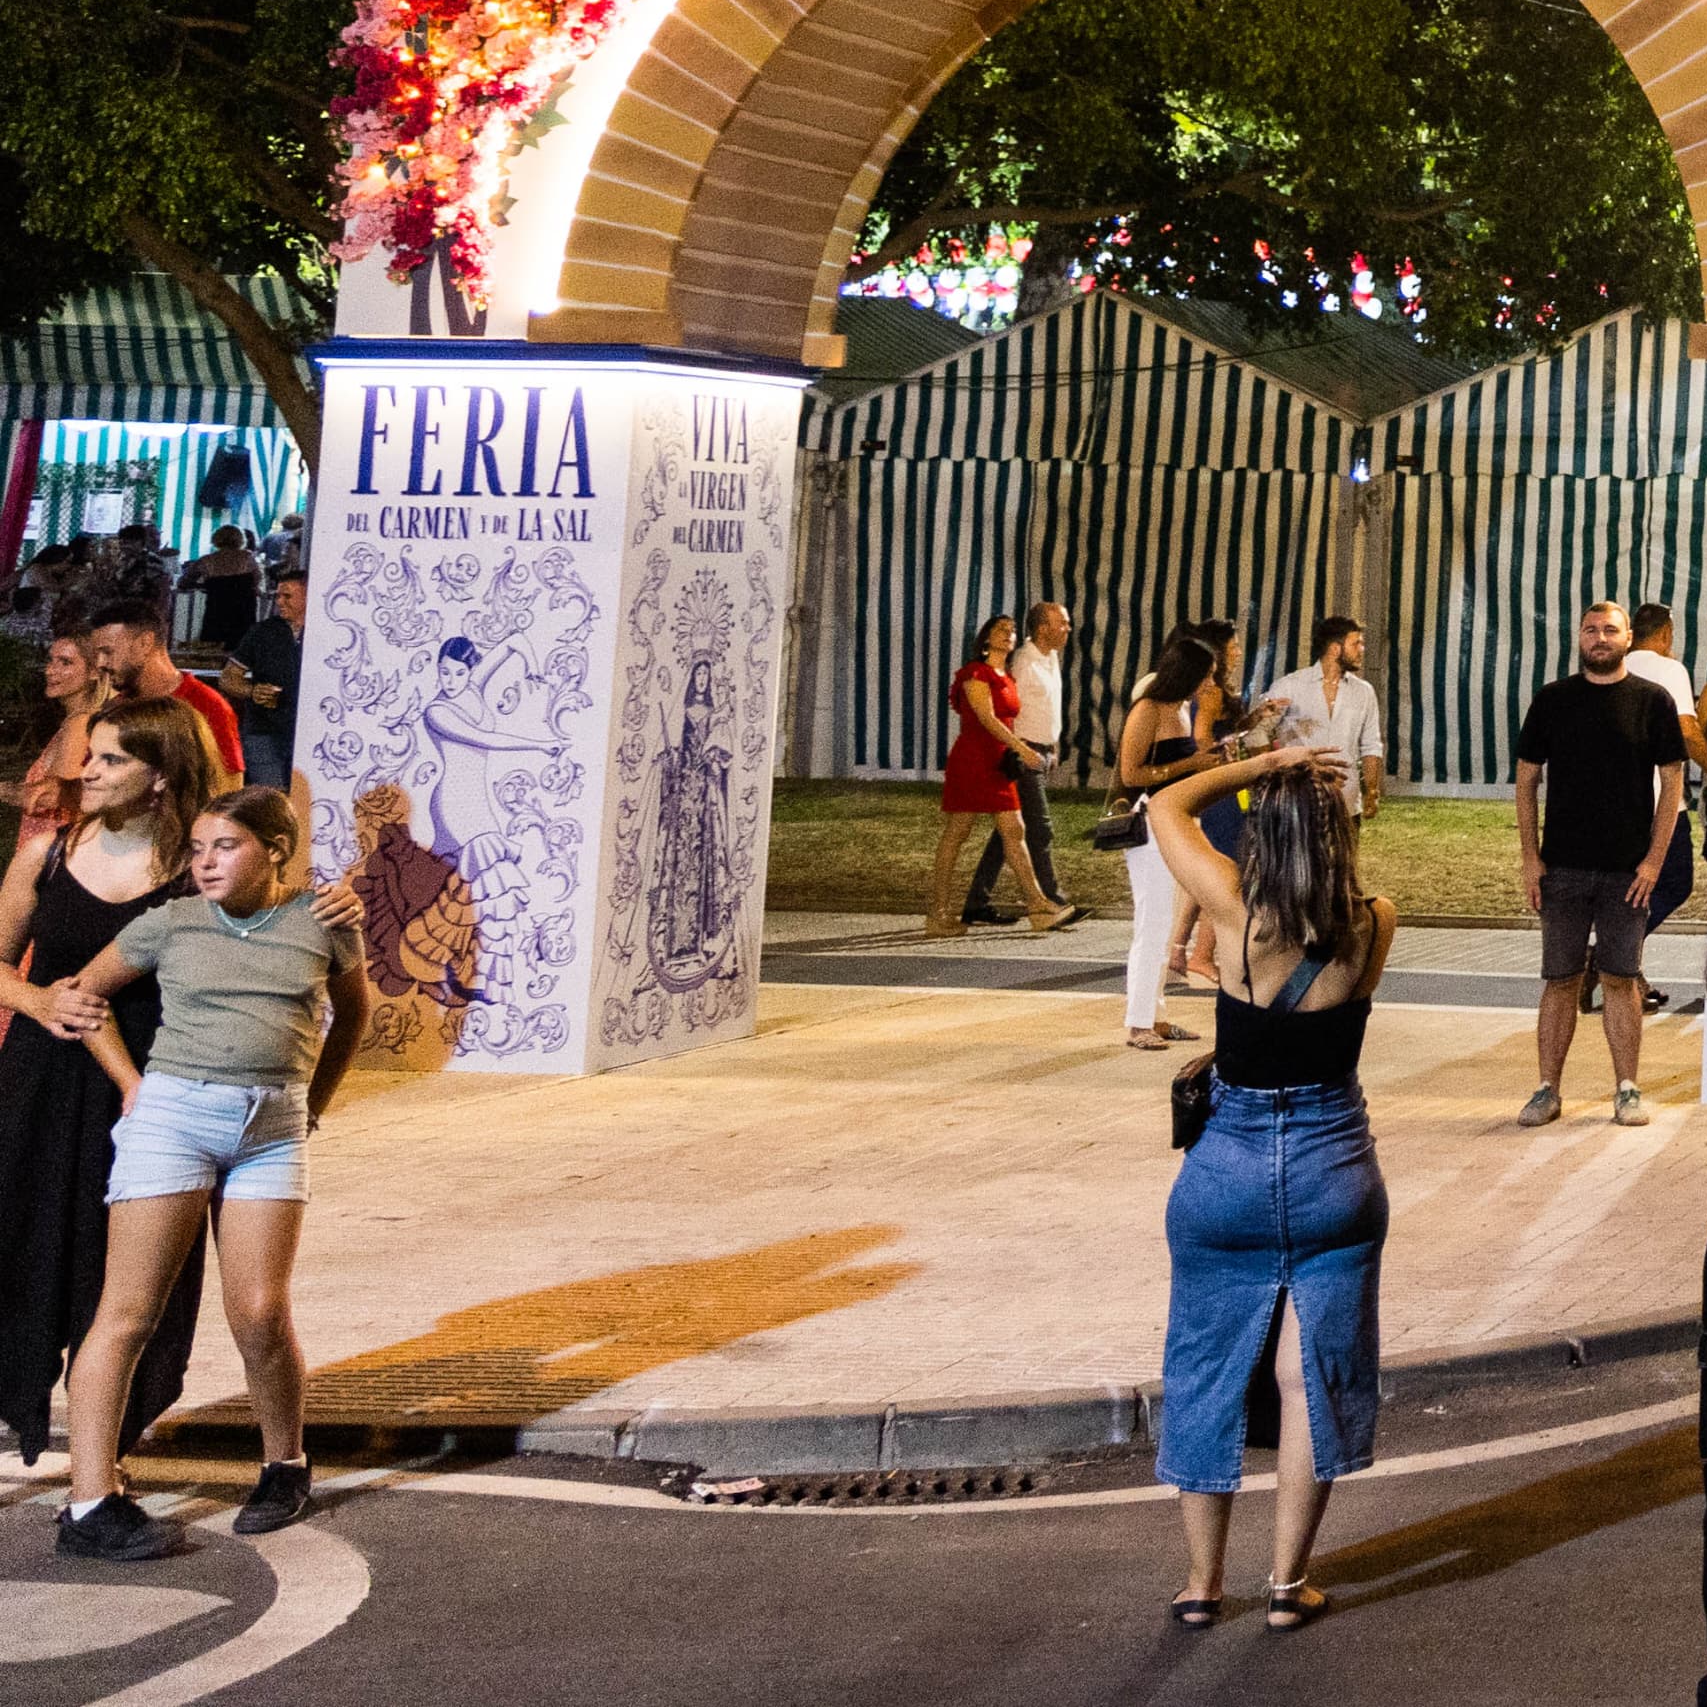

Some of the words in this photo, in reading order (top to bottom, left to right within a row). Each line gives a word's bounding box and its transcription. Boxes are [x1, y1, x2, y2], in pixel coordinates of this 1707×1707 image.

[350, 384, 596, 498] FERIA
[692, 394, 749, 464] VIVA
[690, 470, 749, 511] VIRGEN
[346, 513, 370, 533] DEL
[379, 505, 472, 540] CARMEN
[481, 514, 488, 534] Y
[493, 515, 509, 534] DE
[517, 508, 543, 541] LA
[552, 508, 592, 542] SAL
[688, 518, 745, 553] CARMEN
